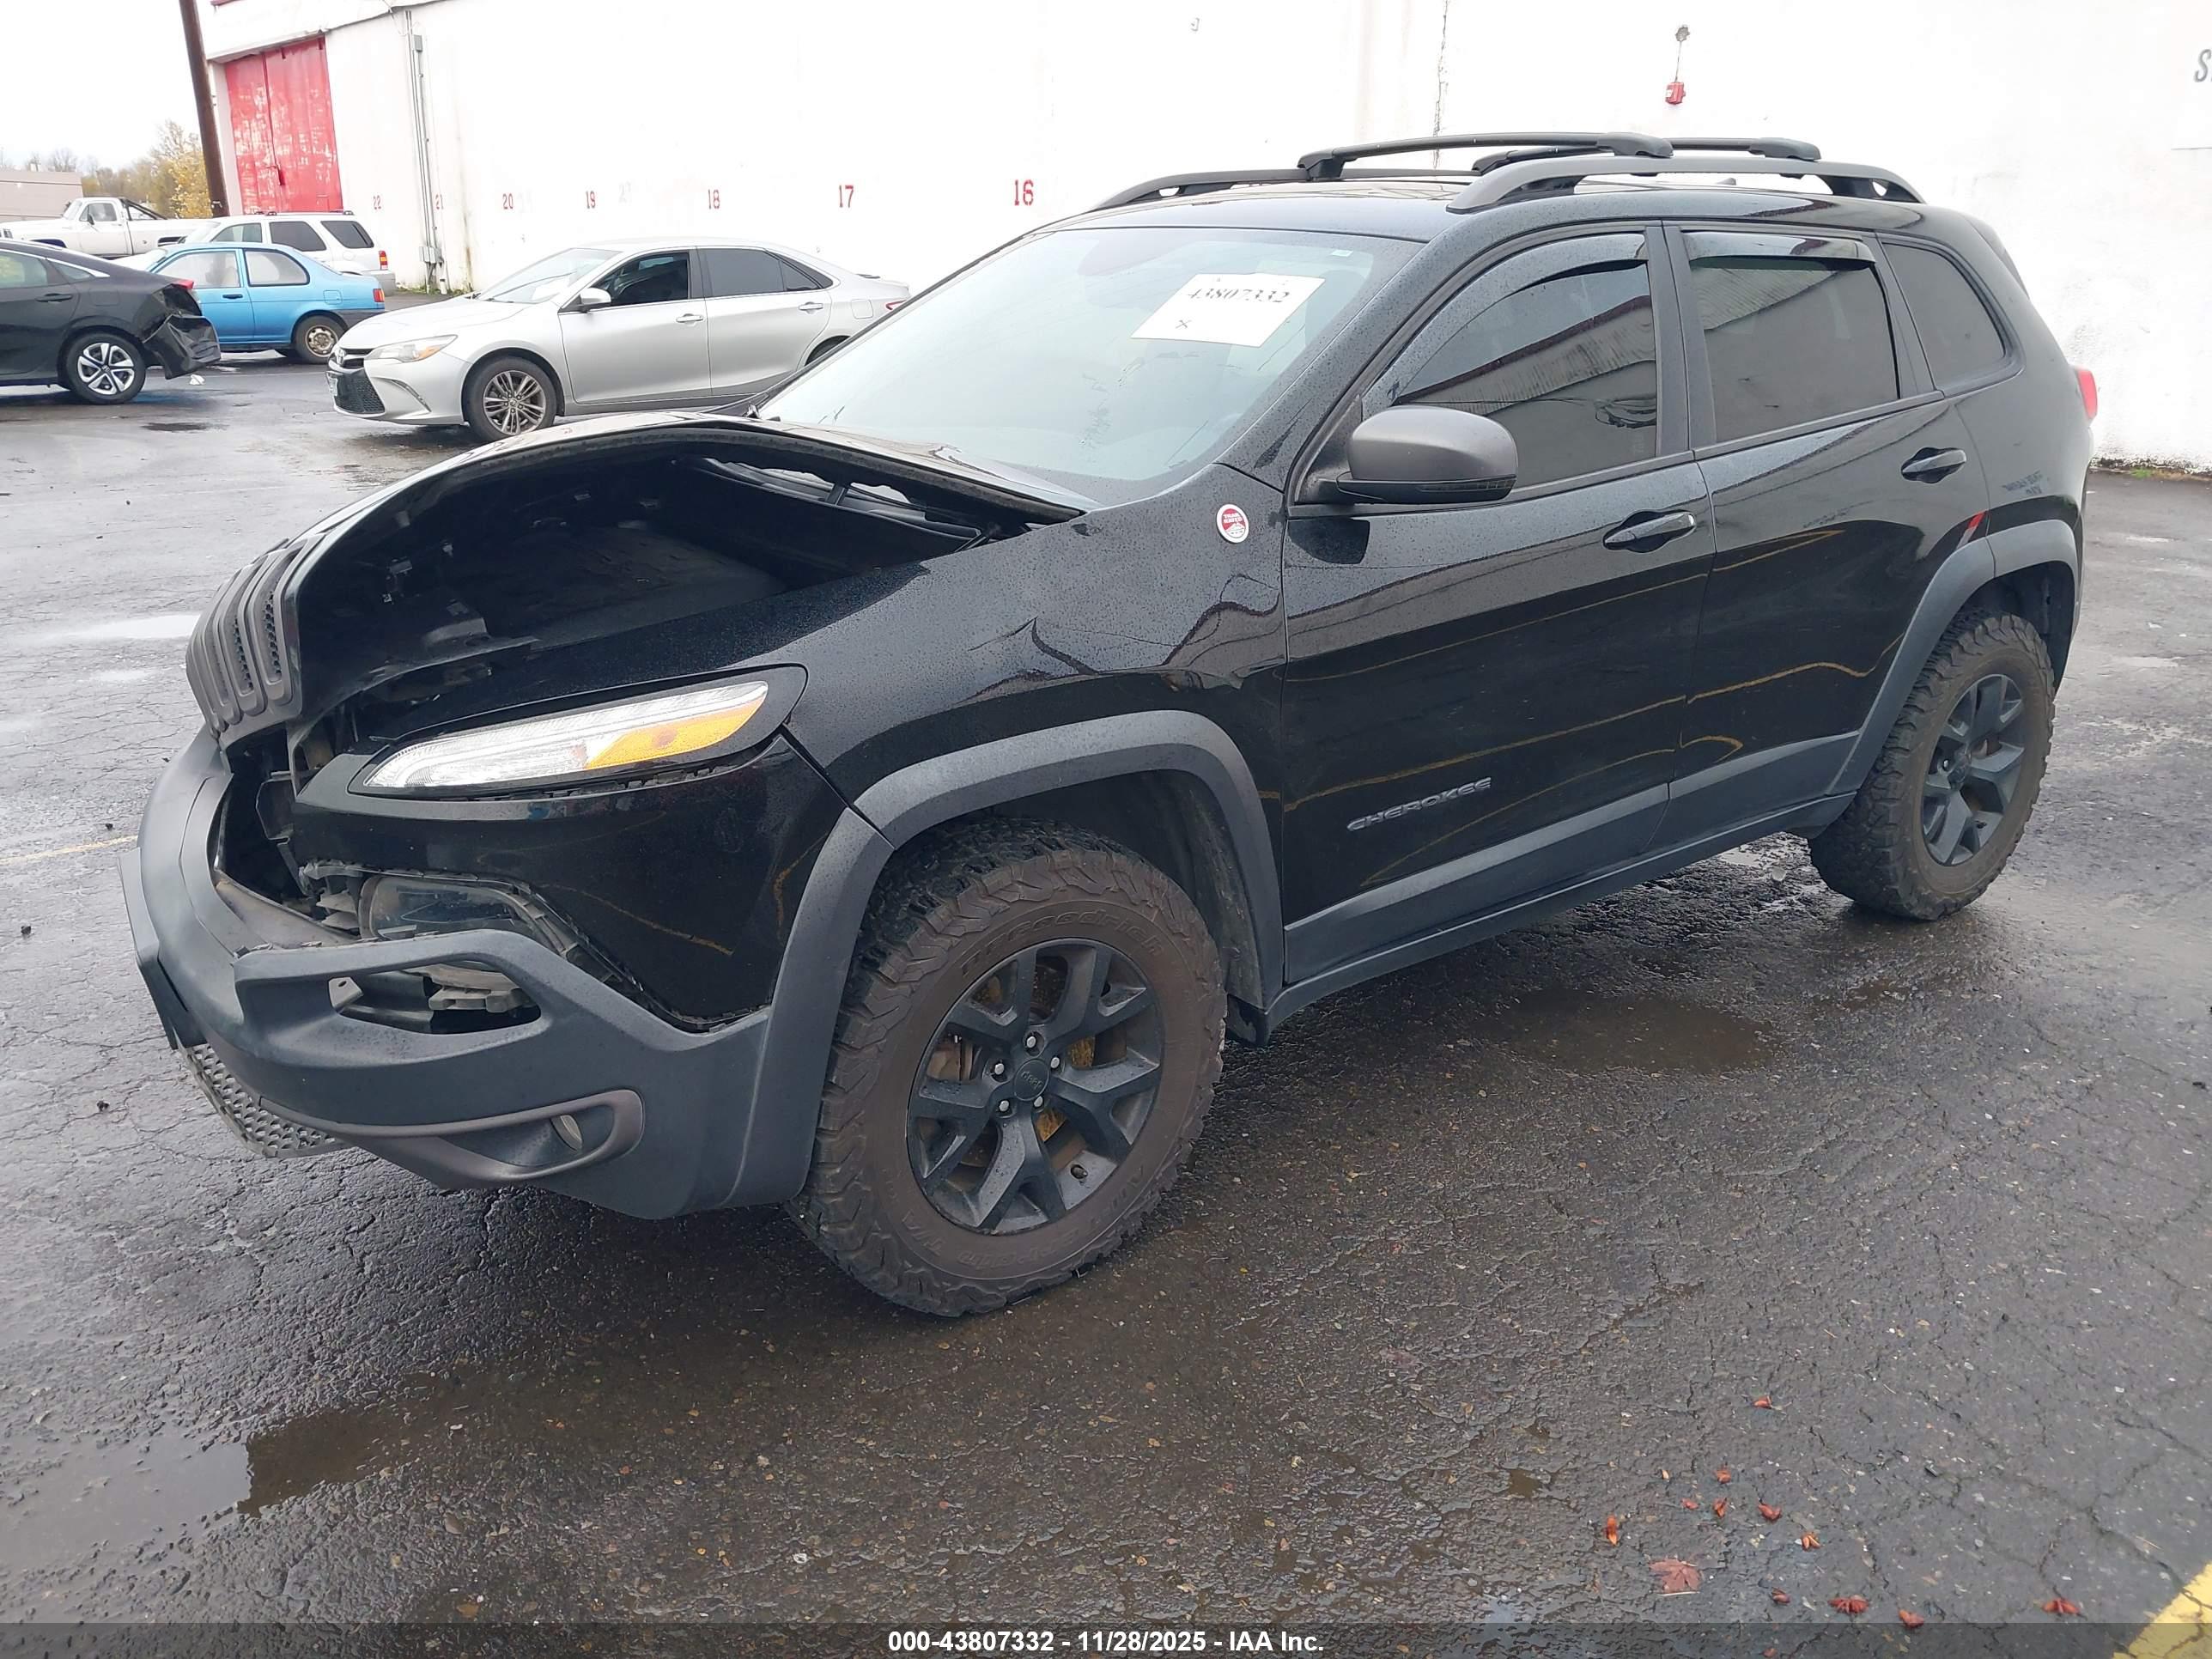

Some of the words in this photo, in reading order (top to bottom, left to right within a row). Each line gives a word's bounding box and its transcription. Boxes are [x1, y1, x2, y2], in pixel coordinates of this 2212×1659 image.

[373, 194, 382, 210] 22
[502, 193, 514, 210] 20
[585, 190, 597, 210] 19
[708, 189, 720, 210] 18
[839, 185, 854, 208] 17
[1014, 179, 1034, 206] 16
[1186, 288, 1291, 303] 43807332
[1346, 776, 1492, 832] CHEROKEE
